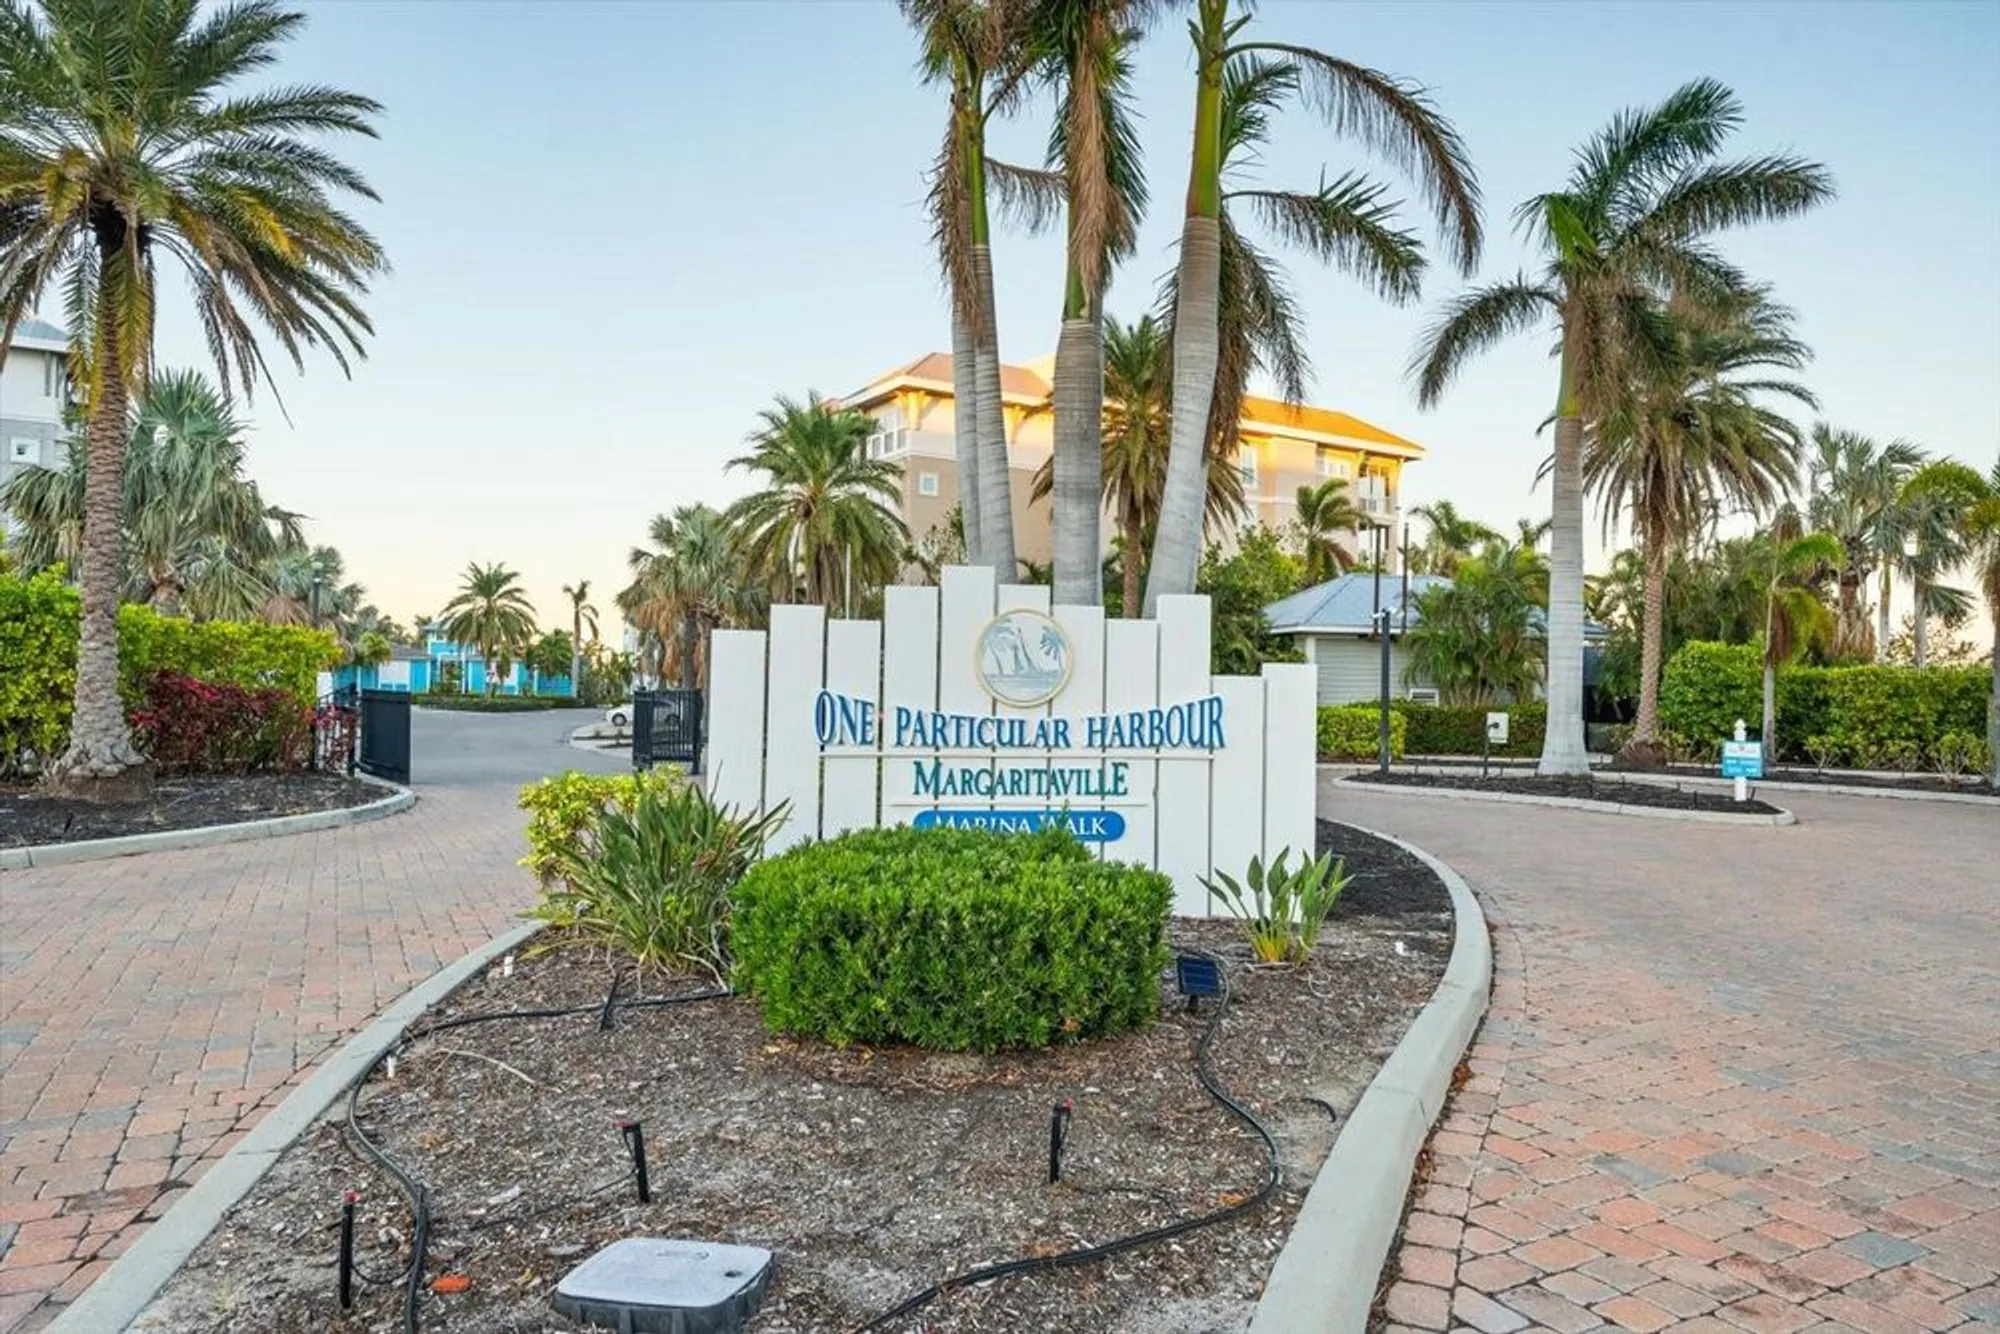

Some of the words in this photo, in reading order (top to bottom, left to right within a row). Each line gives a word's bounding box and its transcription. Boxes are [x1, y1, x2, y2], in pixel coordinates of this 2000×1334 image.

[814, 690, 876, 747] ONE
[895, 706, 1071, 748] PARTICULAR
[1086, 694, 1226, 748] HARBOUR
[913, 761, 1129, 797] MARGARITAVILLE
